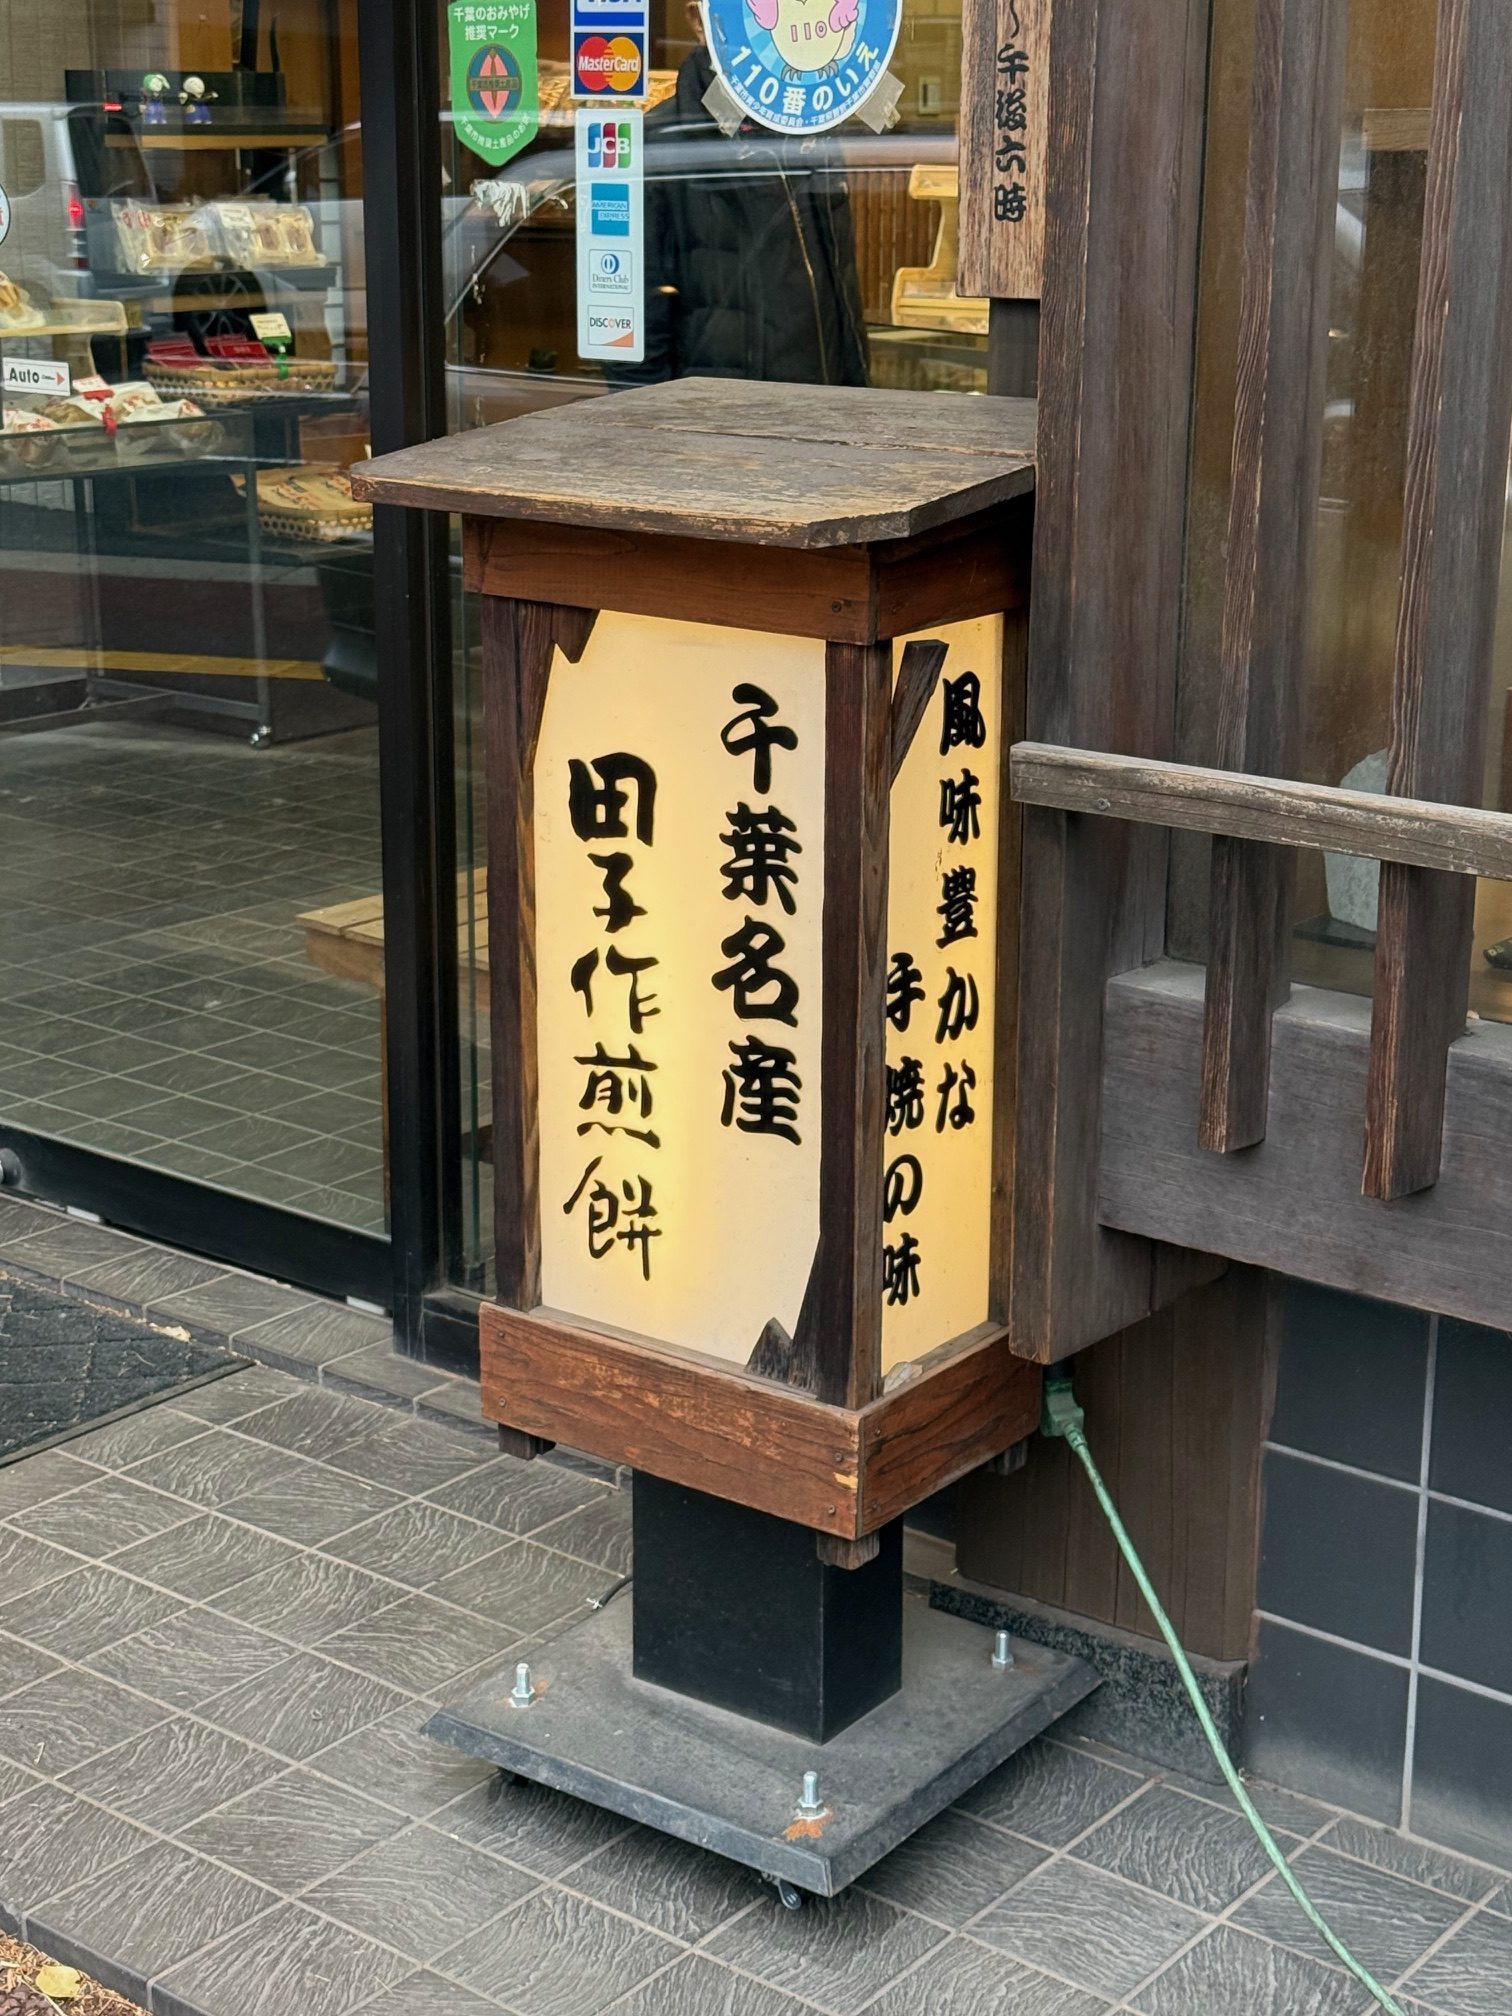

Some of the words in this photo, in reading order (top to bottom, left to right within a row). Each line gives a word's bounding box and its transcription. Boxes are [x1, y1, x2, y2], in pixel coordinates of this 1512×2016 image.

[453, 4, 530, 22] 千葉のおみやげ
[464, 24, 519, 41] 推奨マーク
[791, 21, 828, 42] 110
[578, 56, 639, 72] MasterCard
[730, 41, 878, 115] 110番のいえ
[588, 137, 630, 154] JCB
[592, 201, 627, 209] AMERICAN
[599, 211, 630, 220] EXPRESS
[592, 274, 612, 283] Diners
[613, 275, 629, 284] Club
[590, 317, 632, 329] DISCOVER
[9, 367, 40, 383] Auto
[935, 671, 986, 1133] 風味豊かな
[712, 683, 802, 1145] 千葉名産
[563, 752, 661, 1281] 田子作煎餅
[883, 952, 926, 1306] 手焼の味
